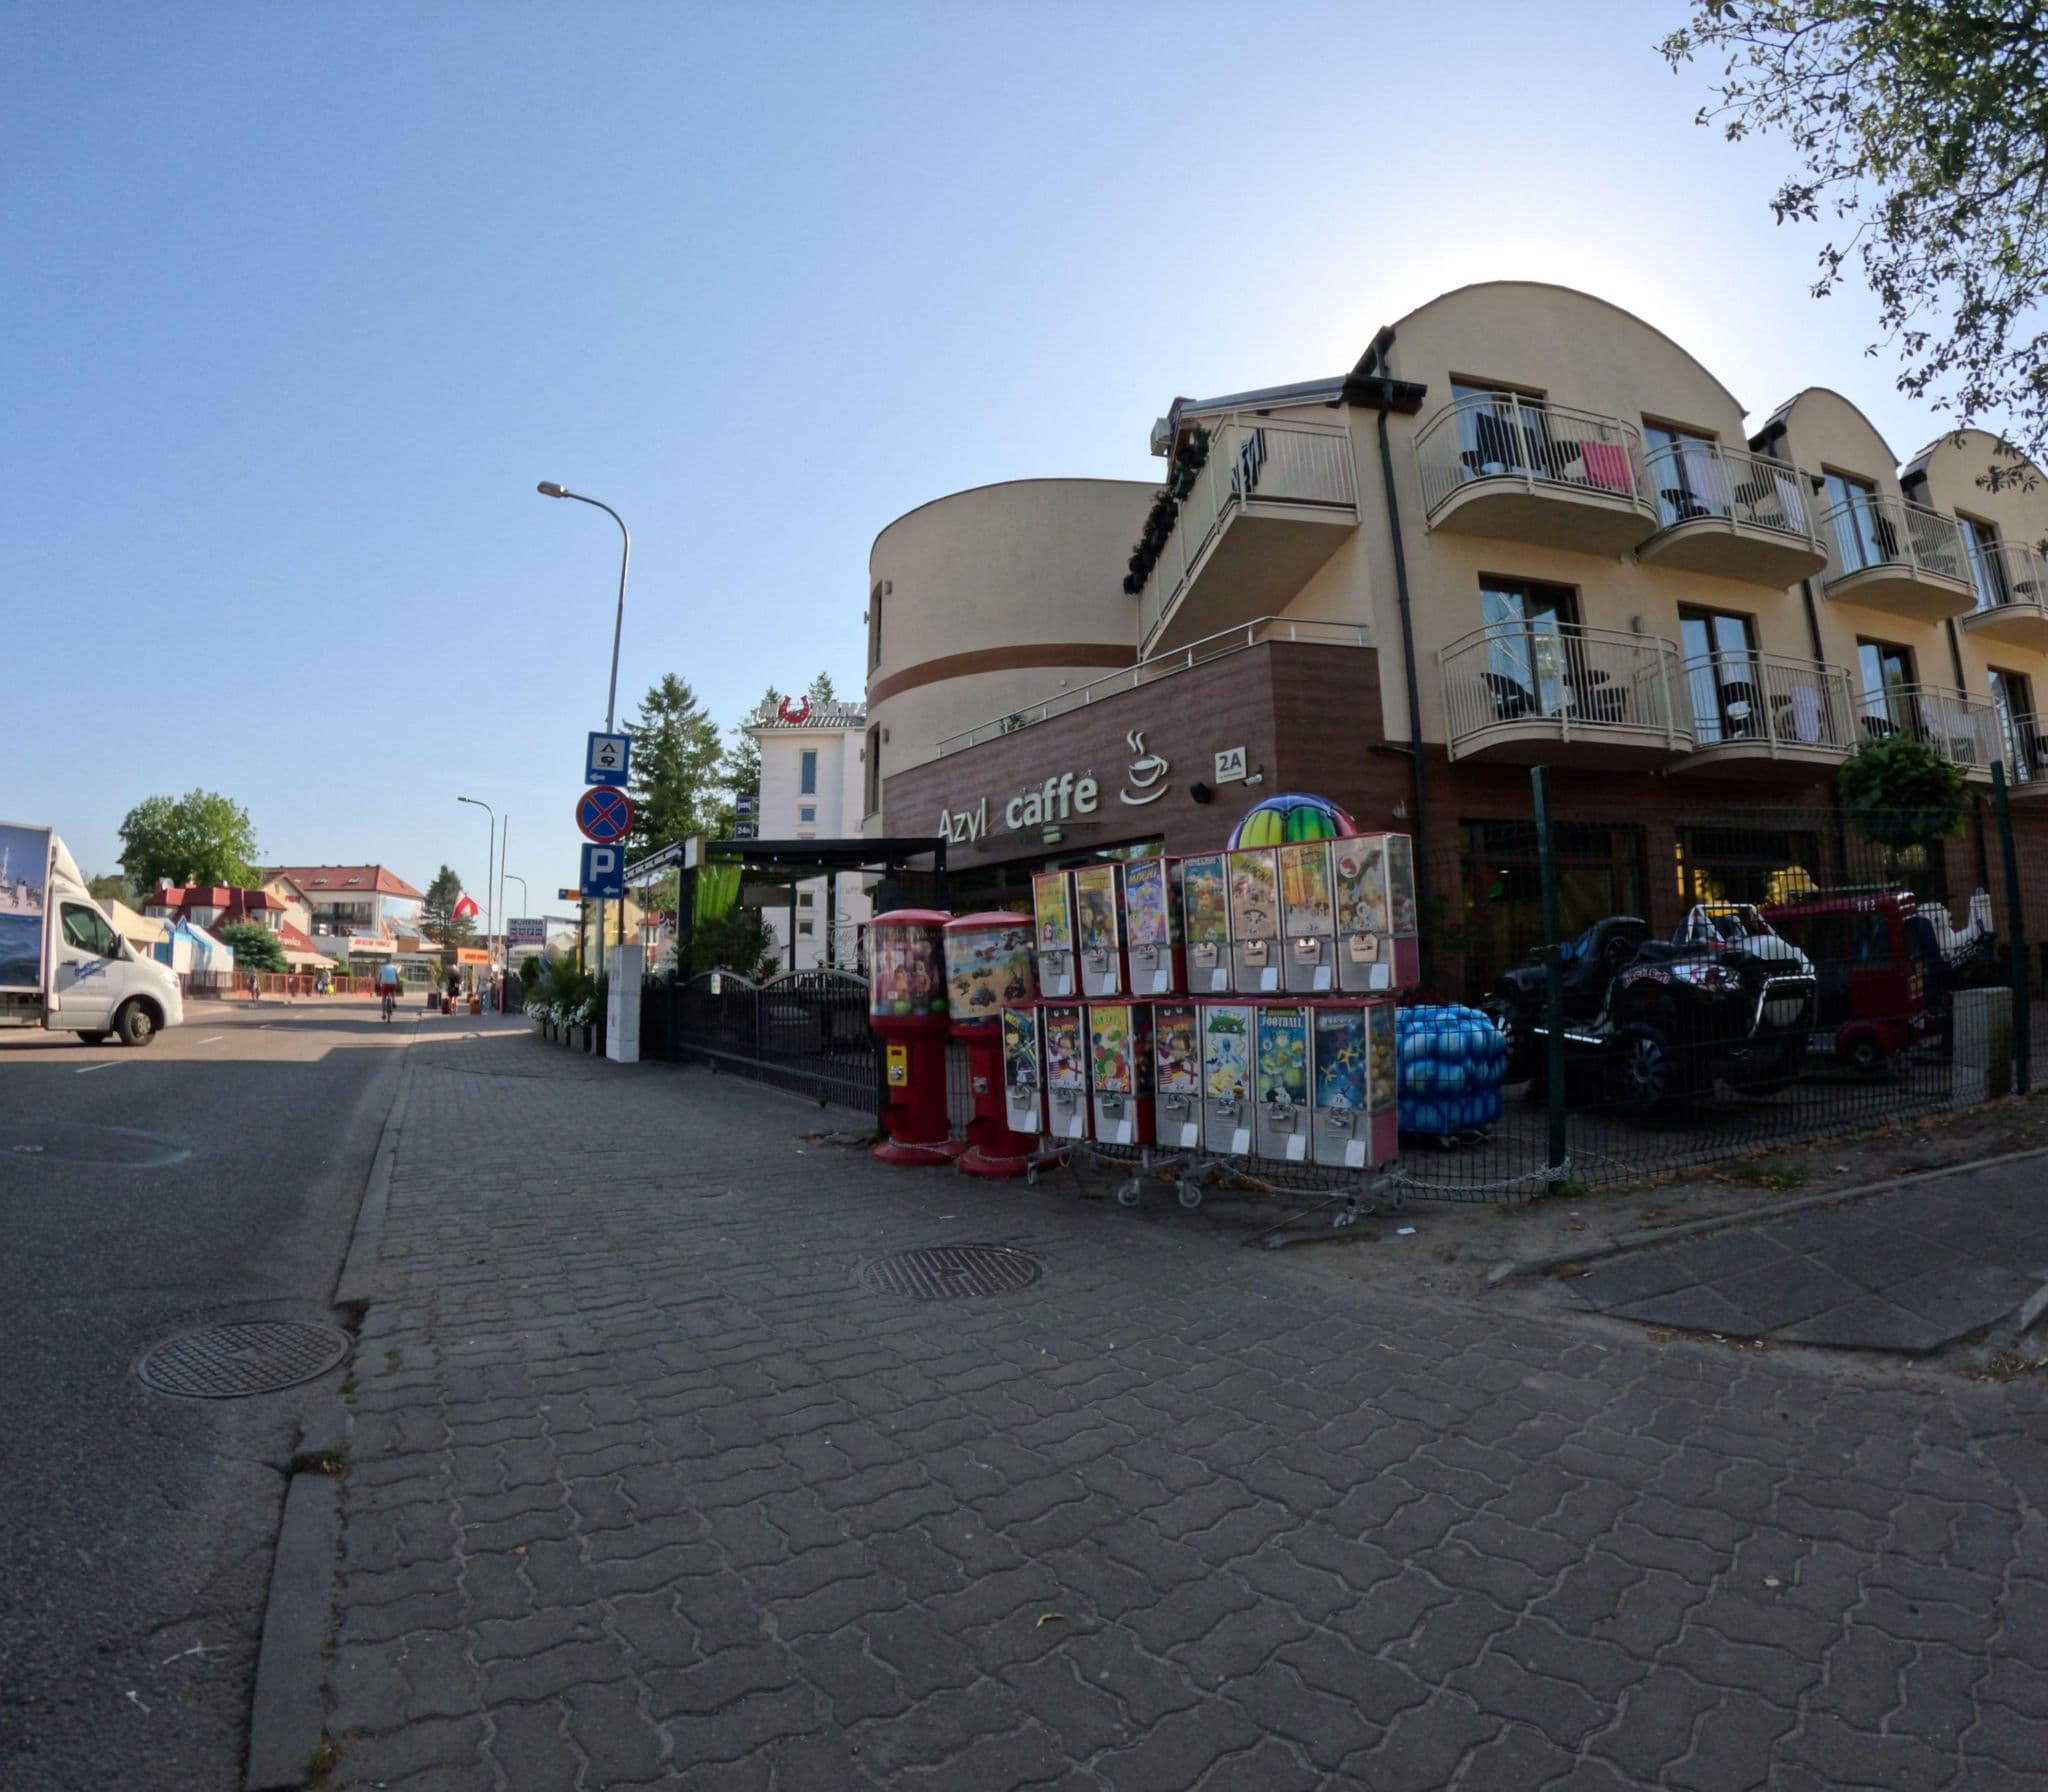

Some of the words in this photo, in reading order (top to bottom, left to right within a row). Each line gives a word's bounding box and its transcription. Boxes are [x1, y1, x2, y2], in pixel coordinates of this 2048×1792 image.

[1219, 752, 1242, 772] 2A
[938, 797, 987, 844] Azyl
[1005, 772, 1099, 830] caffe
[589, 848, 615, 882] P
[1262, 1016, 1303, 1028] FOOTBALL
